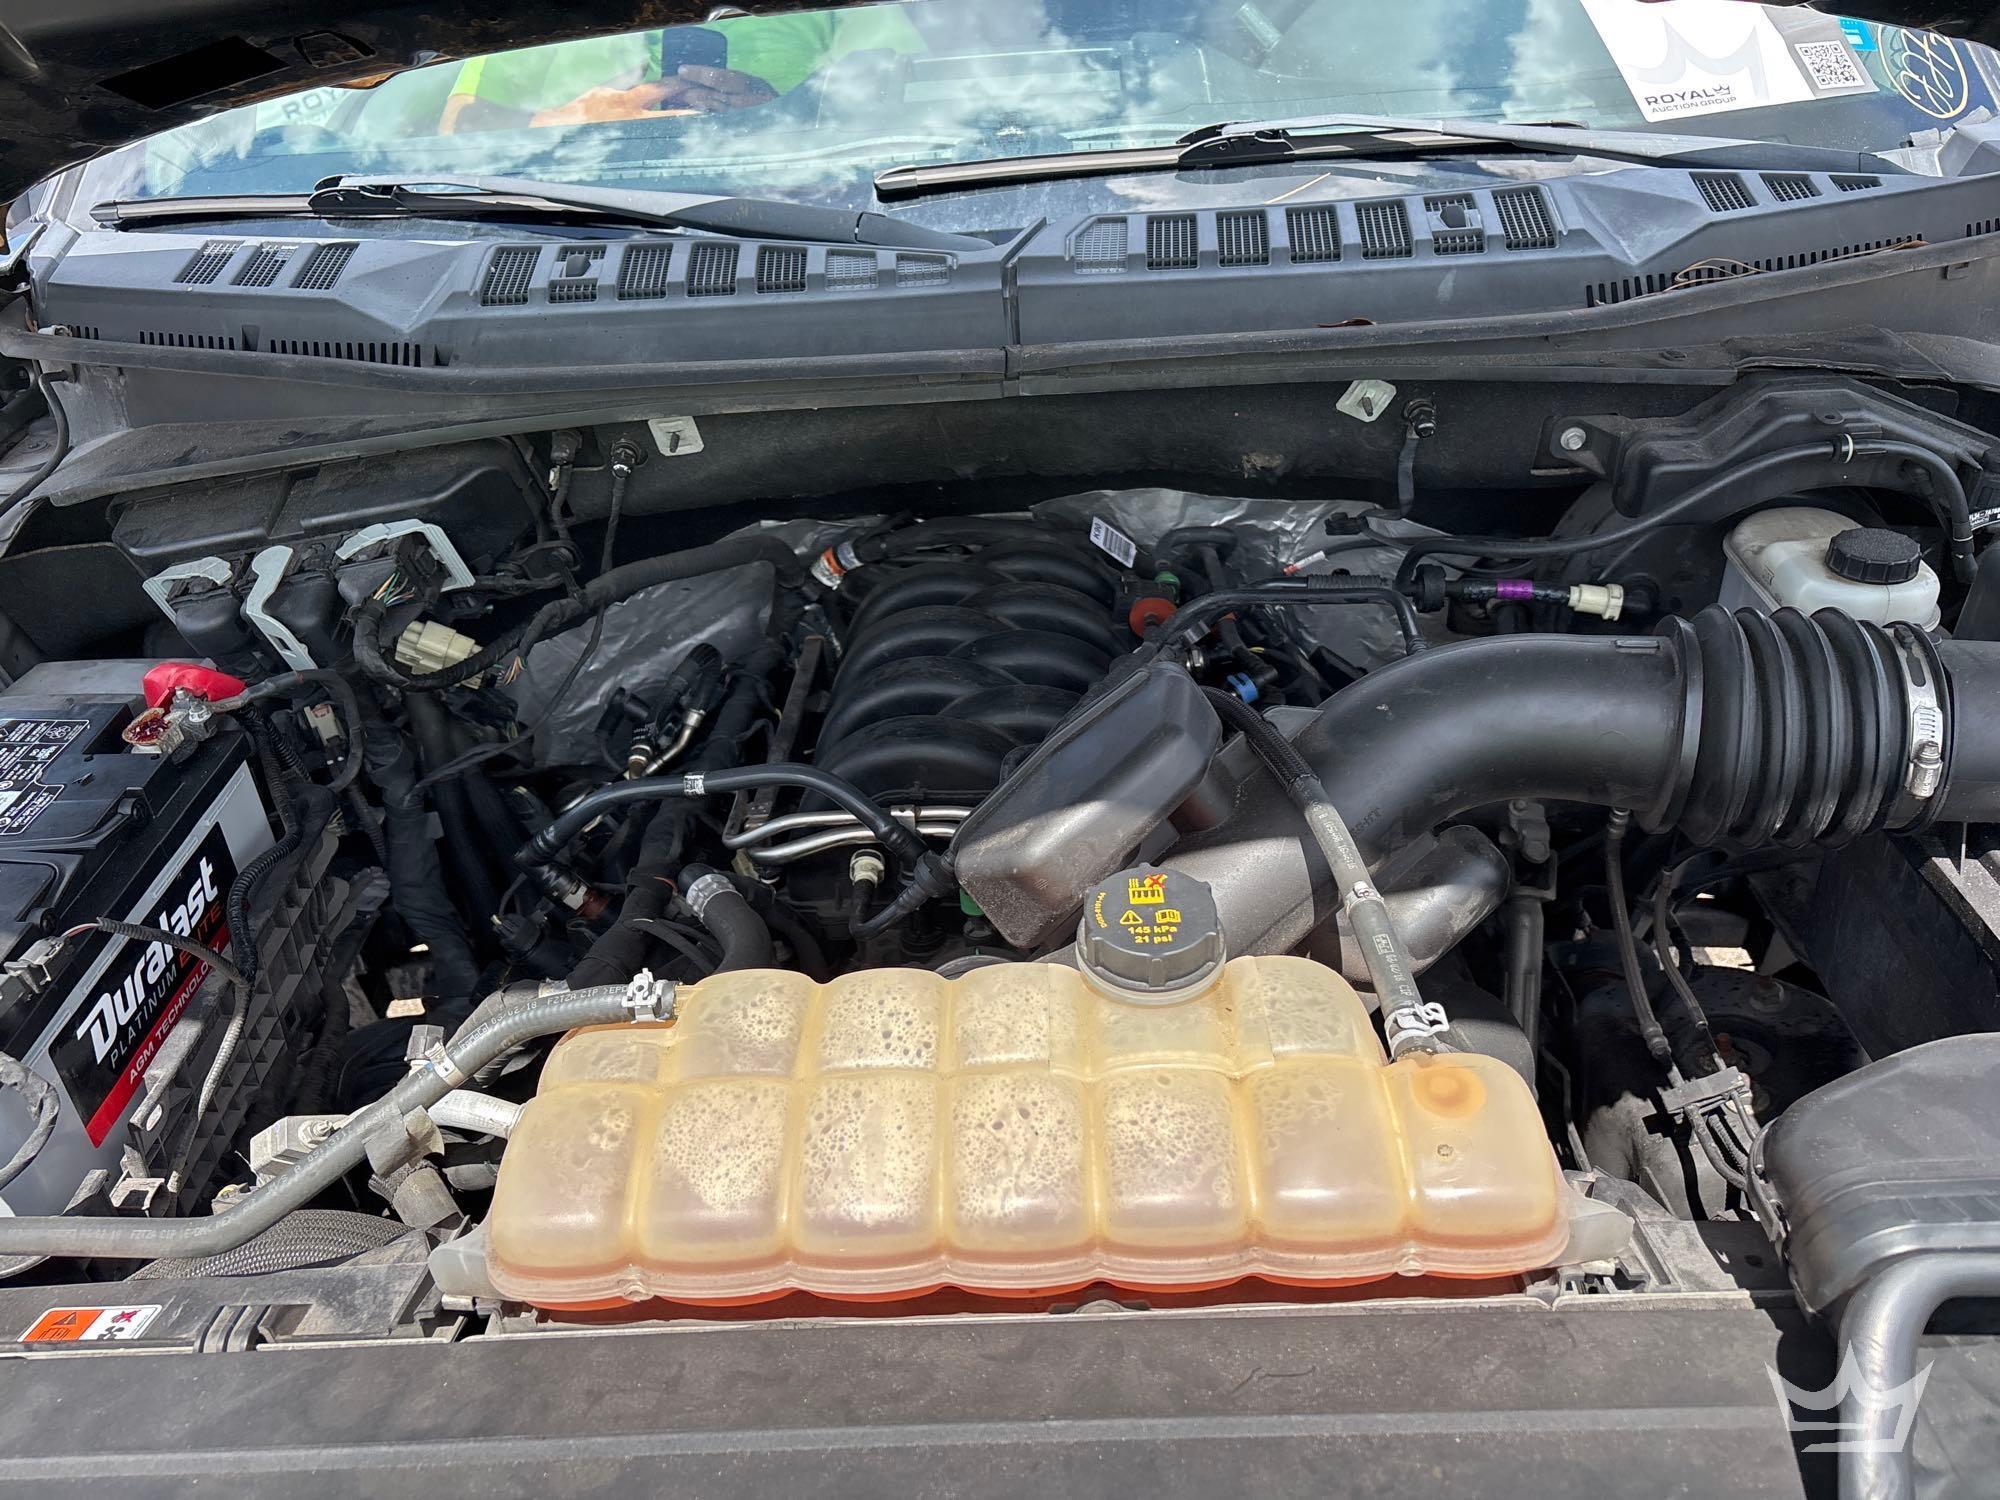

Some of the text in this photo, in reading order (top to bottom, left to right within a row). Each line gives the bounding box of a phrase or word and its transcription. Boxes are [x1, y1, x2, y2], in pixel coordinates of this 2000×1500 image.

[1644, 89, 1715, 106] ROYAL
[1652, 96, 1737, 113] AUCTION GROUP
[1128, 925, 1178, 935] 145 kPa
[1134, 936, 1149, 944] 21
[76, 856, 218, 1065] Duralast
[110, 900, 221, 1069] PLATINUM EITE
[580, 988, 598, 999] CIP
[129, 942, 219, 1084] AGM TECHNOLOY
